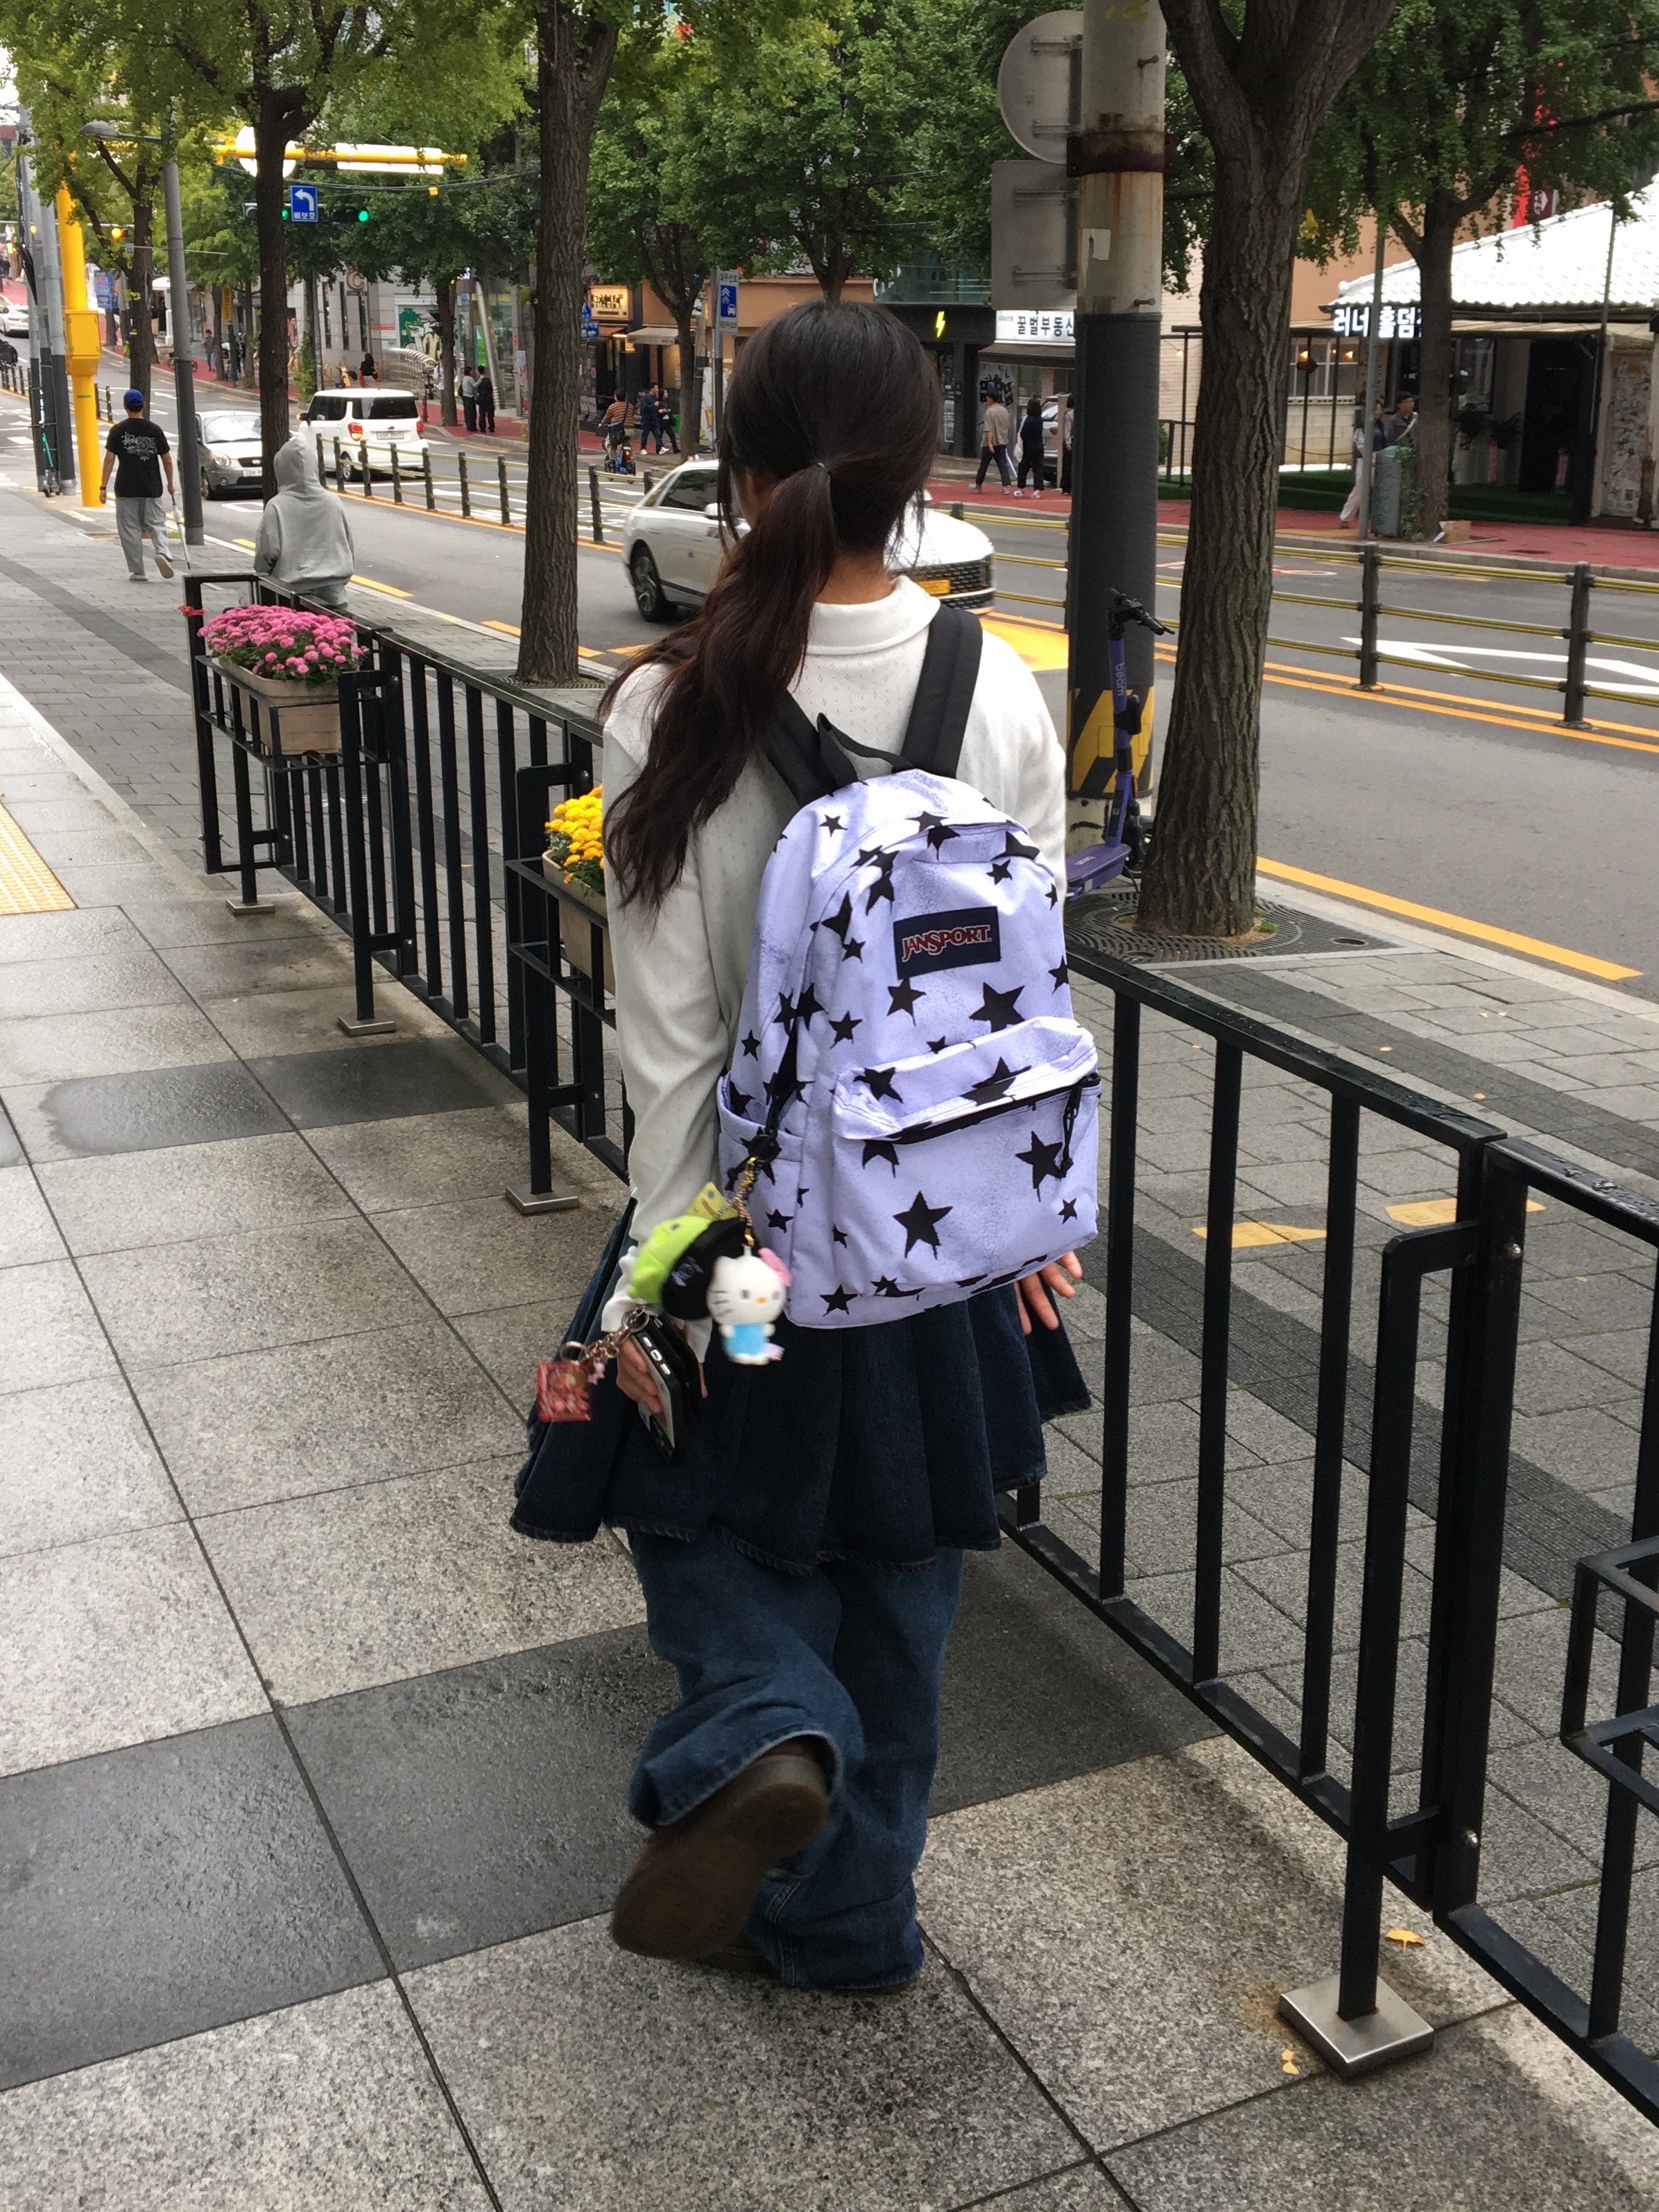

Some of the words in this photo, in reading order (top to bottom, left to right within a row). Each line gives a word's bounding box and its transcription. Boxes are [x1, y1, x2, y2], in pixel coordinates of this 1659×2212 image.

[293, 212, 316, 220] 비보호
[1333, 307, 1370, 337] 러너
[1379, 306, 1422, 338] 홀덤
[1115, 662, 1125, 696] beam
[902, 924, 990, 963] JANSPORT
